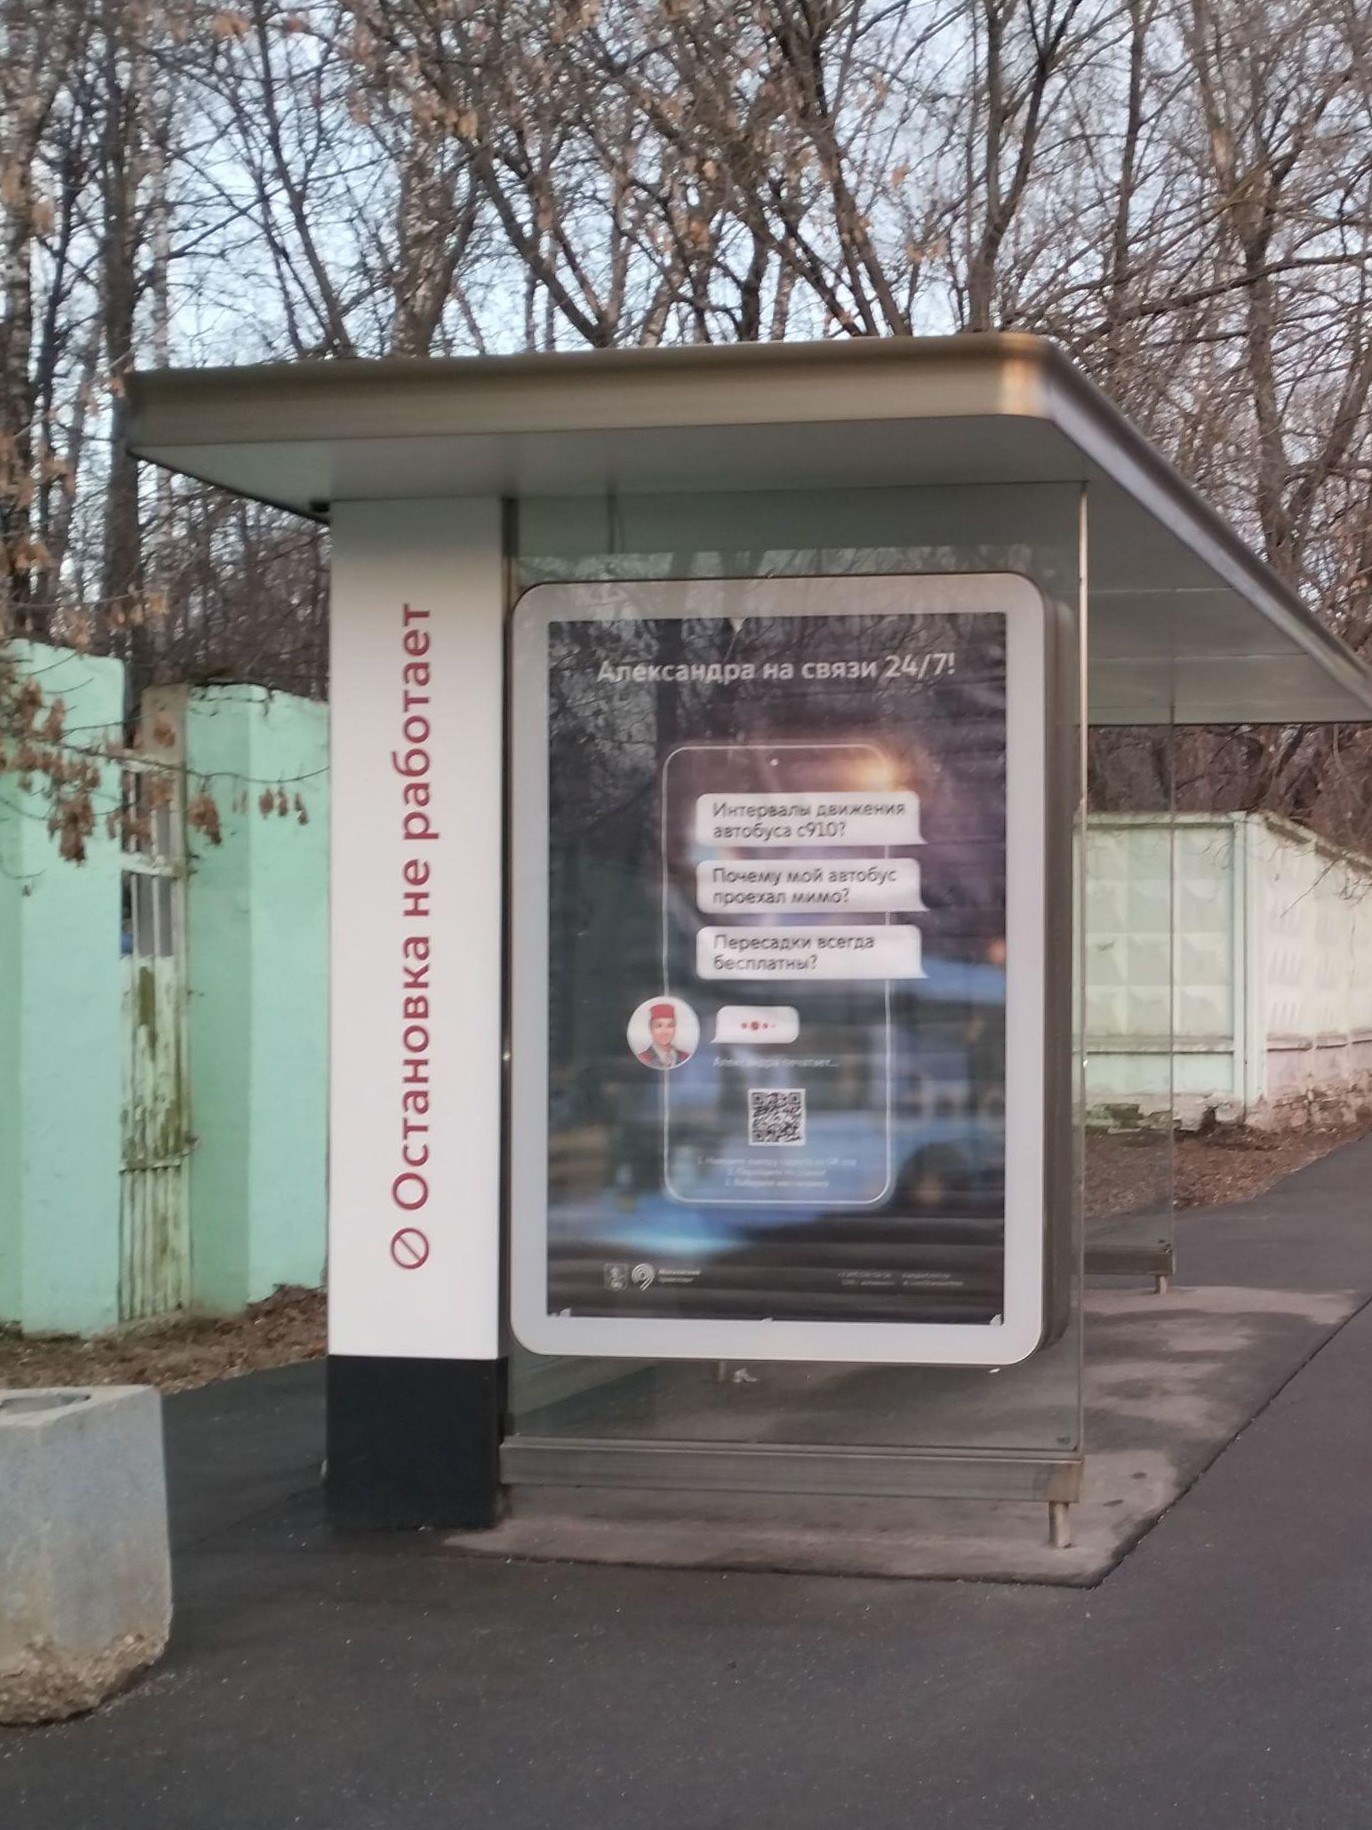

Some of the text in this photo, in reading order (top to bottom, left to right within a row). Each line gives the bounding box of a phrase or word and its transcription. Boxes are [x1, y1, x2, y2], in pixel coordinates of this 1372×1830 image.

[597, 653, 956, 684] Александра на связи 24/7!
[713, 802, 906, 819] Интервалы движения
[714, 822, 847, 841] автобуса с910?
[713, 866, 897, 885] Почему мой автобус
[714, 888, 850, 907] проехал мимо?
[390, 605, 440, 1213] Остановка не работает
[714, 934, 876, 951] Пересадки всегда
[714, 955, 819, 970] бесплатны?
